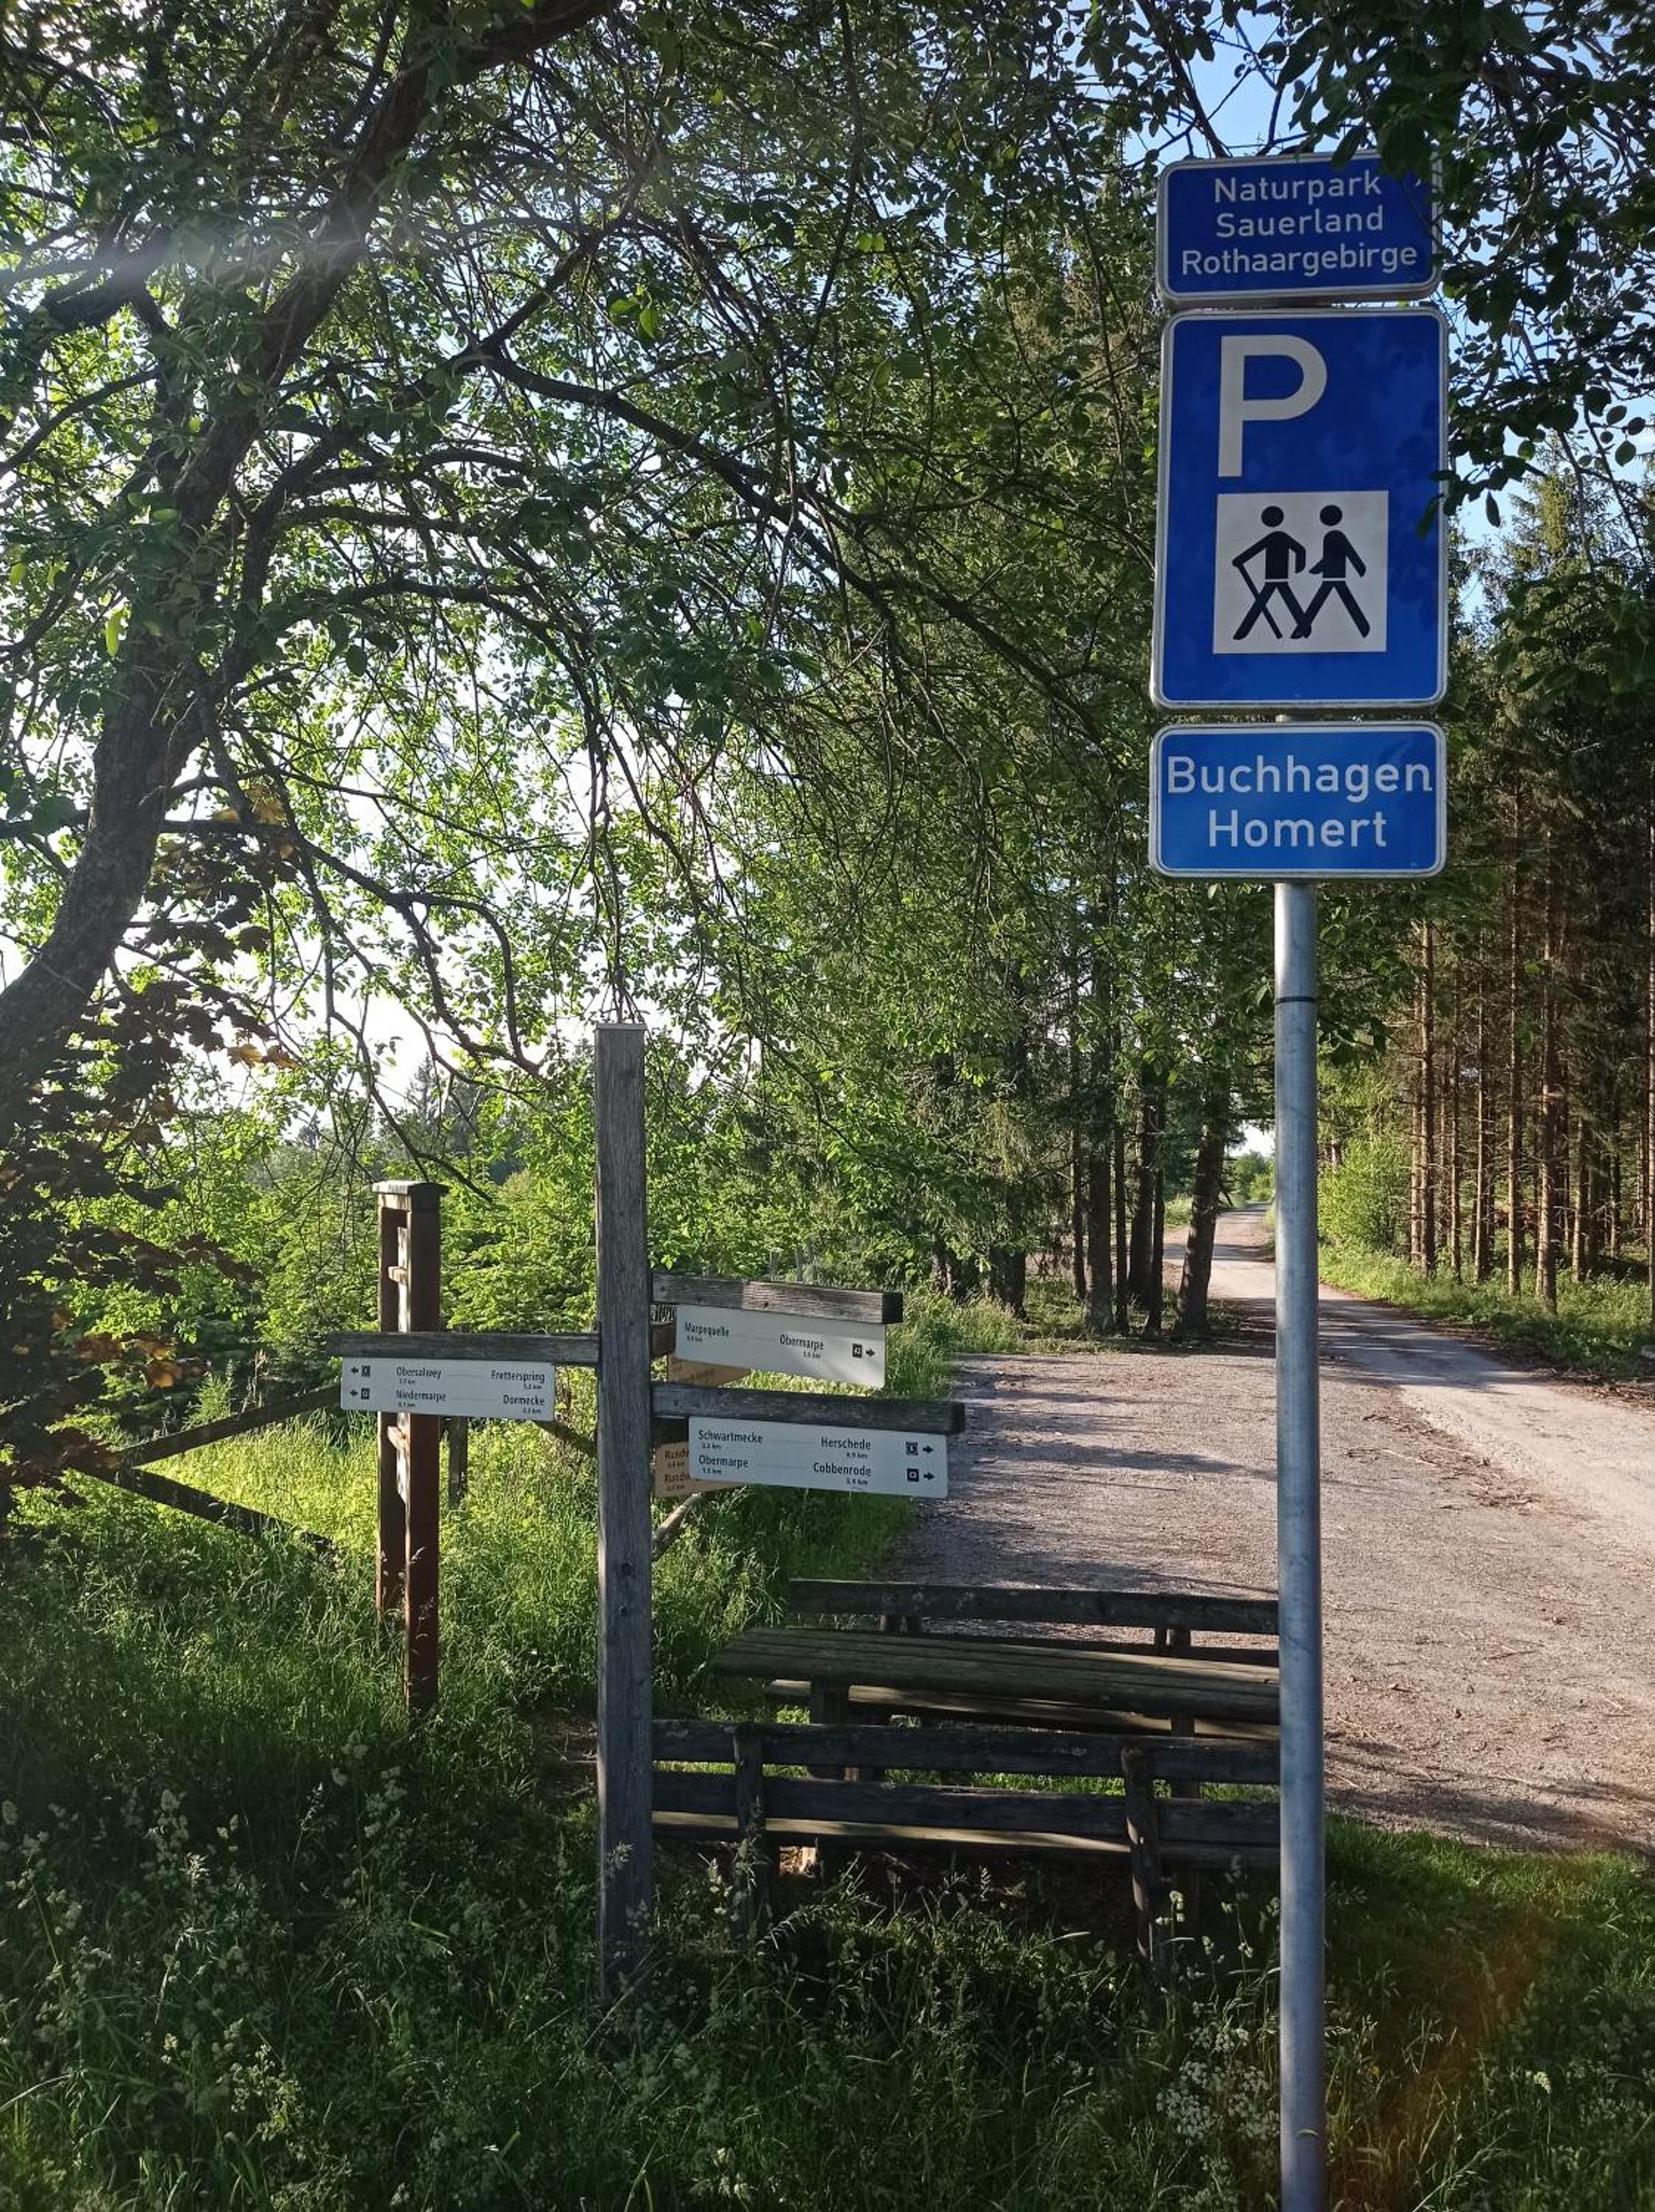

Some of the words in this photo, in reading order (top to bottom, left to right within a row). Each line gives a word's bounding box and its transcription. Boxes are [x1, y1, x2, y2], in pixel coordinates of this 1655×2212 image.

[1215, 170, 1381, 205] Naturpark
[1216, 204, 1384, 237] Sauerland
[1182, 243, 1418, 277] Rothaargebirge
[1218, 334, 1328, 478] P
[1167, 755, 1433, 803] Buchhagen
[1209, 810, 1387, 847] Homert
[684, 1322, 730, 1338] Marpequelle
[780, 1334, 825, 1351] Obermarpe
[396, 1366, 442, 1379] Obersalwey
[490, 1369, 545, 1384] Fretterspring
[396, 1389, 446, 1403] Niedermarpe
[503, 1394, 545, 1406] Dormecke
[698, 1430, 763, 1443] Schwartmecke
[821, 1436, 871, 1450] Herschede
[698, 1455, 749, 1470] Obermarpe
[813, 1462, 871, 1477] Cobbenrode
